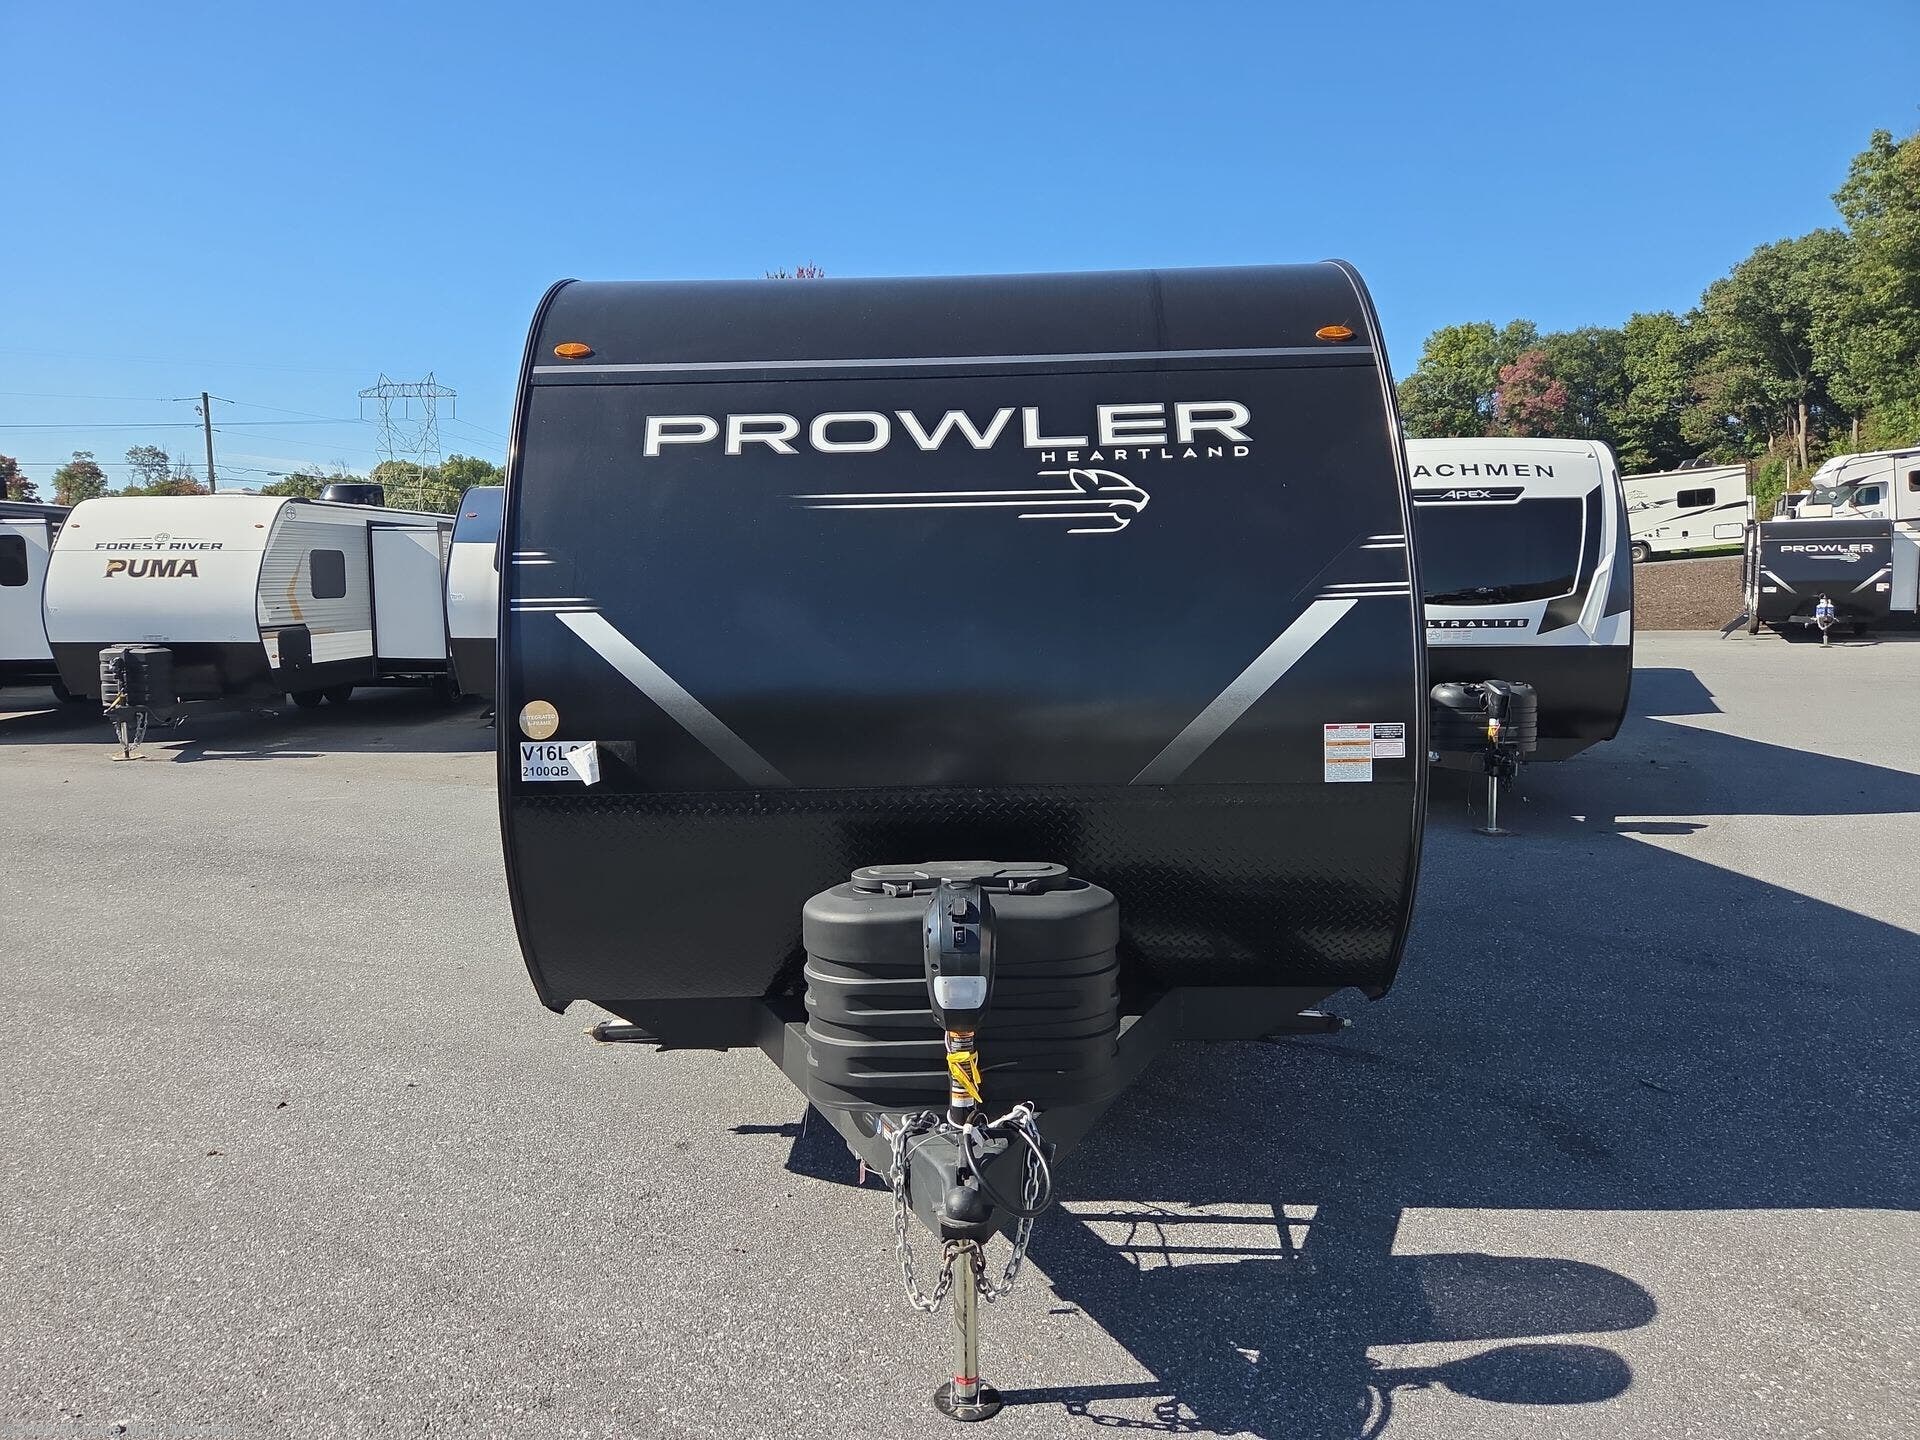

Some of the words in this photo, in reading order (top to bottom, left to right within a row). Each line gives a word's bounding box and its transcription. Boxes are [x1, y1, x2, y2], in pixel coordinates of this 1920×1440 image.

[642, 400, 1254, 457] PROWLER
[1041, 445, 1250, 463] HEARTLAND
[1413, 463, 1554, 478] ACHMEN
[1440, 489, 1491, 500] APEX
[95, 542, 165, 550] FOREST
[169, 542, 223, 550] RIVER
[1780, 544, 1874, 553] PROWLER
[103, 558, 199, 579] PUMA
[1427, 620, 1525, 628] LTRALITE
[523, 766, 569, 777] 2100QB
